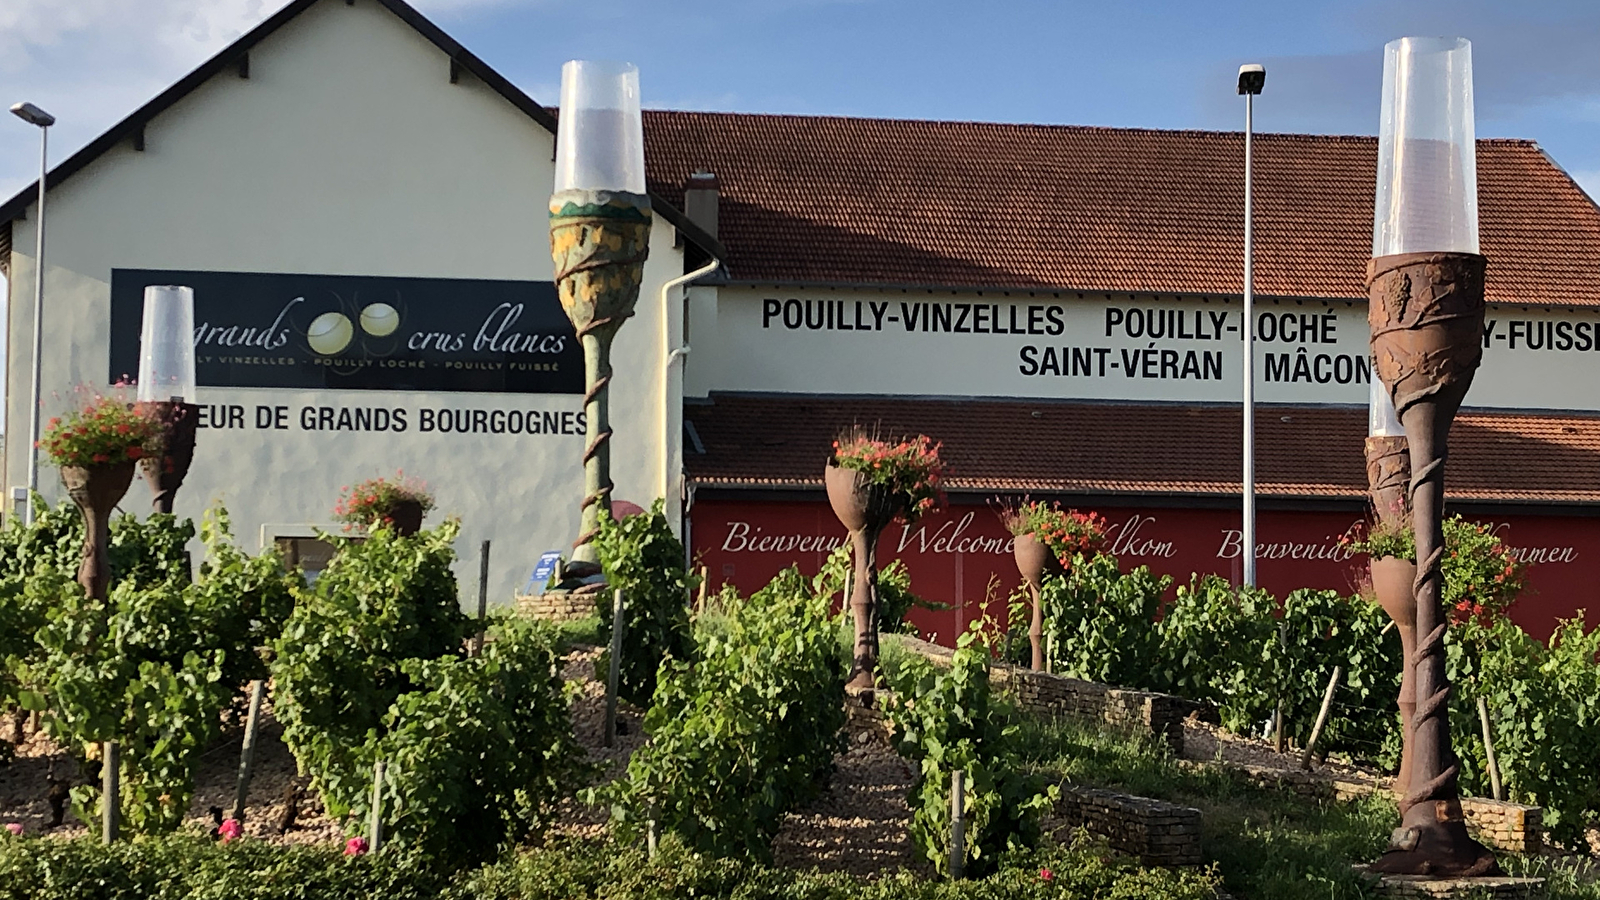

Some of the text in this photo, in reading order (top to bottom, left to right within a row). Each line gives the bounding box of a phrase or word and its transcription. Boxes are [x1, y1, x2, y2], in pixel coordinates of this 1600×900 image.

[193, 296, 567, 354] grands crus blancs
[763, 298, 1065, 335] POUILLY-VINZELLES
[218, 356, 296, 366] VINZELLES
[314, 358, 373, 367] POUILLY
[379, 359, 426, 369] LOCHÉ
[445, 361, 503, 371] POUILLY
[509, 361, 560, 373] FUISSÉ
[1019, 343, 1223, 380] SAINT-VÉRAN
[255, 405, 289, 430] DE
[300, 406, 408, 433] GRANDS
[419, 408, 587, 436] BOURGOGNES
[896, 511, 1015, 555] Welcome
[1216, 519, 1365, 563] Benvenido
